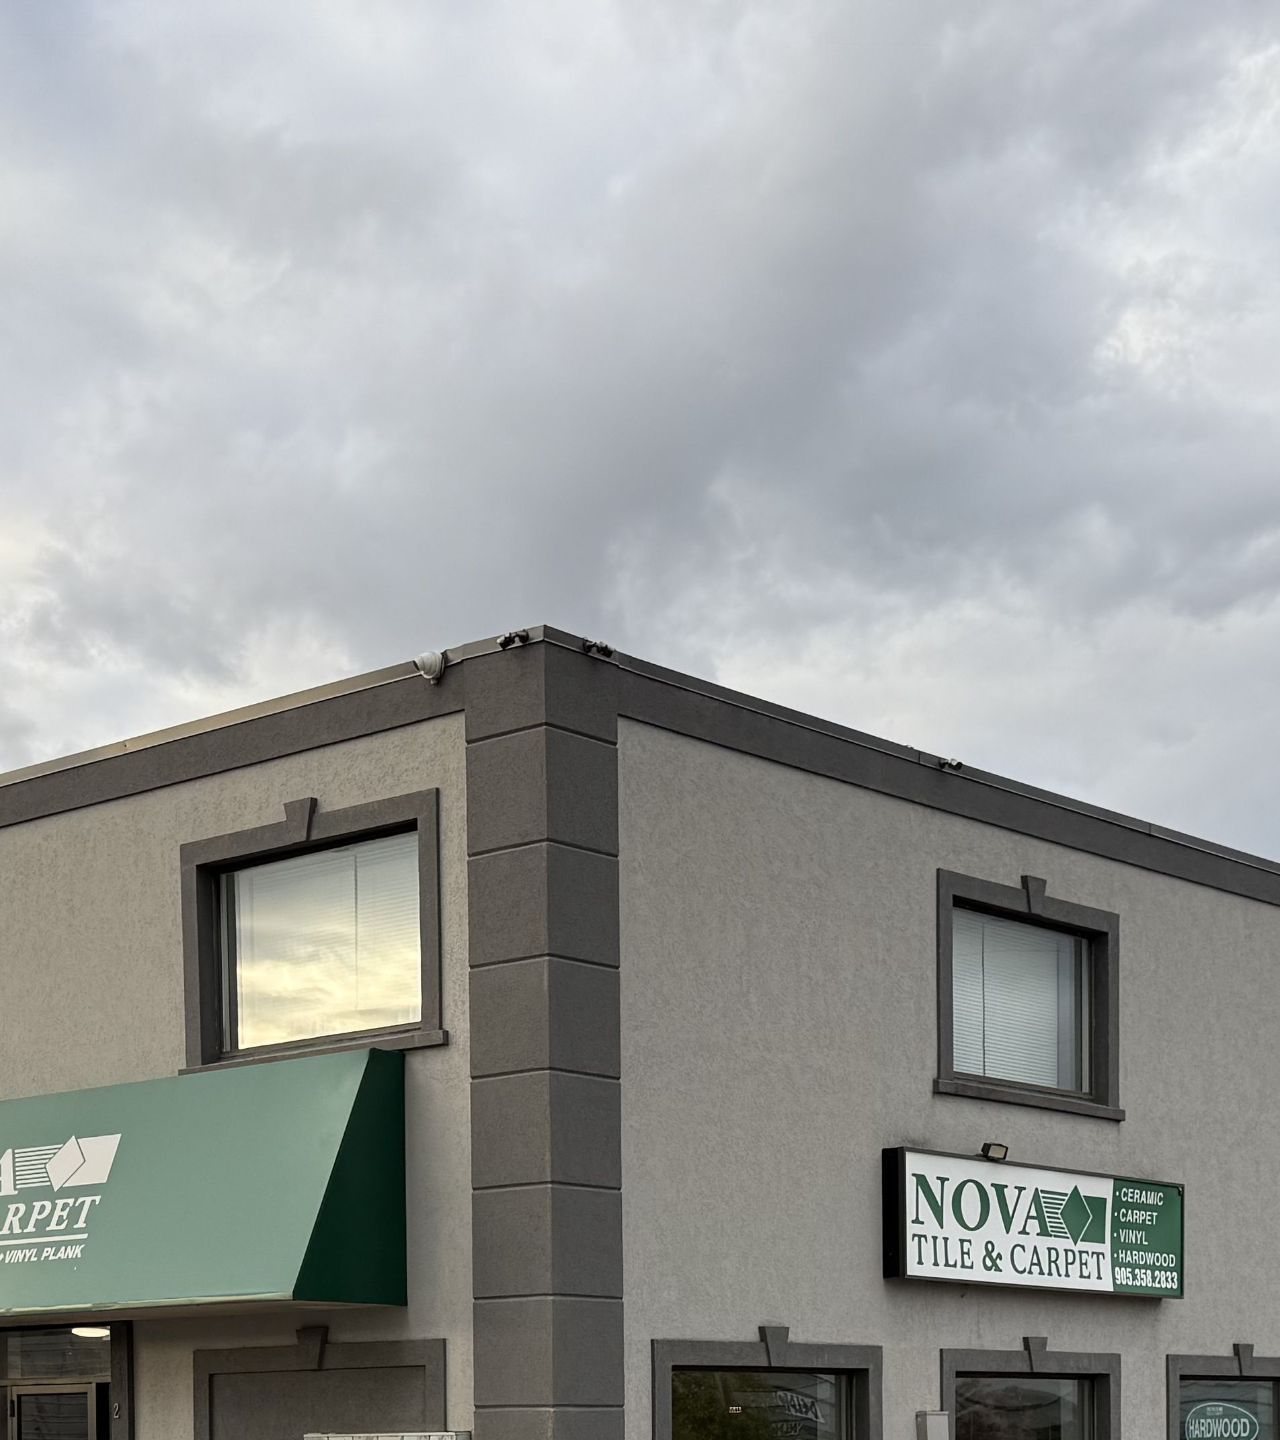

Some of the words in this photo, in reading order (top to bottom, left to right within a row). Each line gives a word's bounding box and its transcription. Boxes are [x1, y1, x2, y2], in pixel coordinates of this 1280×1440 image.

[911, 1173, 1054, 1238] NOVA
[1121, 1188, 1164, 1206] CERAMIC
[1120, 1207, 1158, 1225] CARPET
[1119, 1229, 1149, 1246] VINYL
[5, 1248, 38, 1264] VINYL
[41, 1244, 85, 1261] PLANK
[912, 1233, 974, 1270] TILE
[982, 1240, 1003, 1273] &
[1010, 1244, 1105, 1281] CARPET
[1119, 1250, 1176, 1268] HARDWOOD
[1115, 1268, 1178, 1289] 905.358.2833
[113, 1403, 120, 1419] 2
[1189, 1418, 1250, 1438] HARDWOOD
